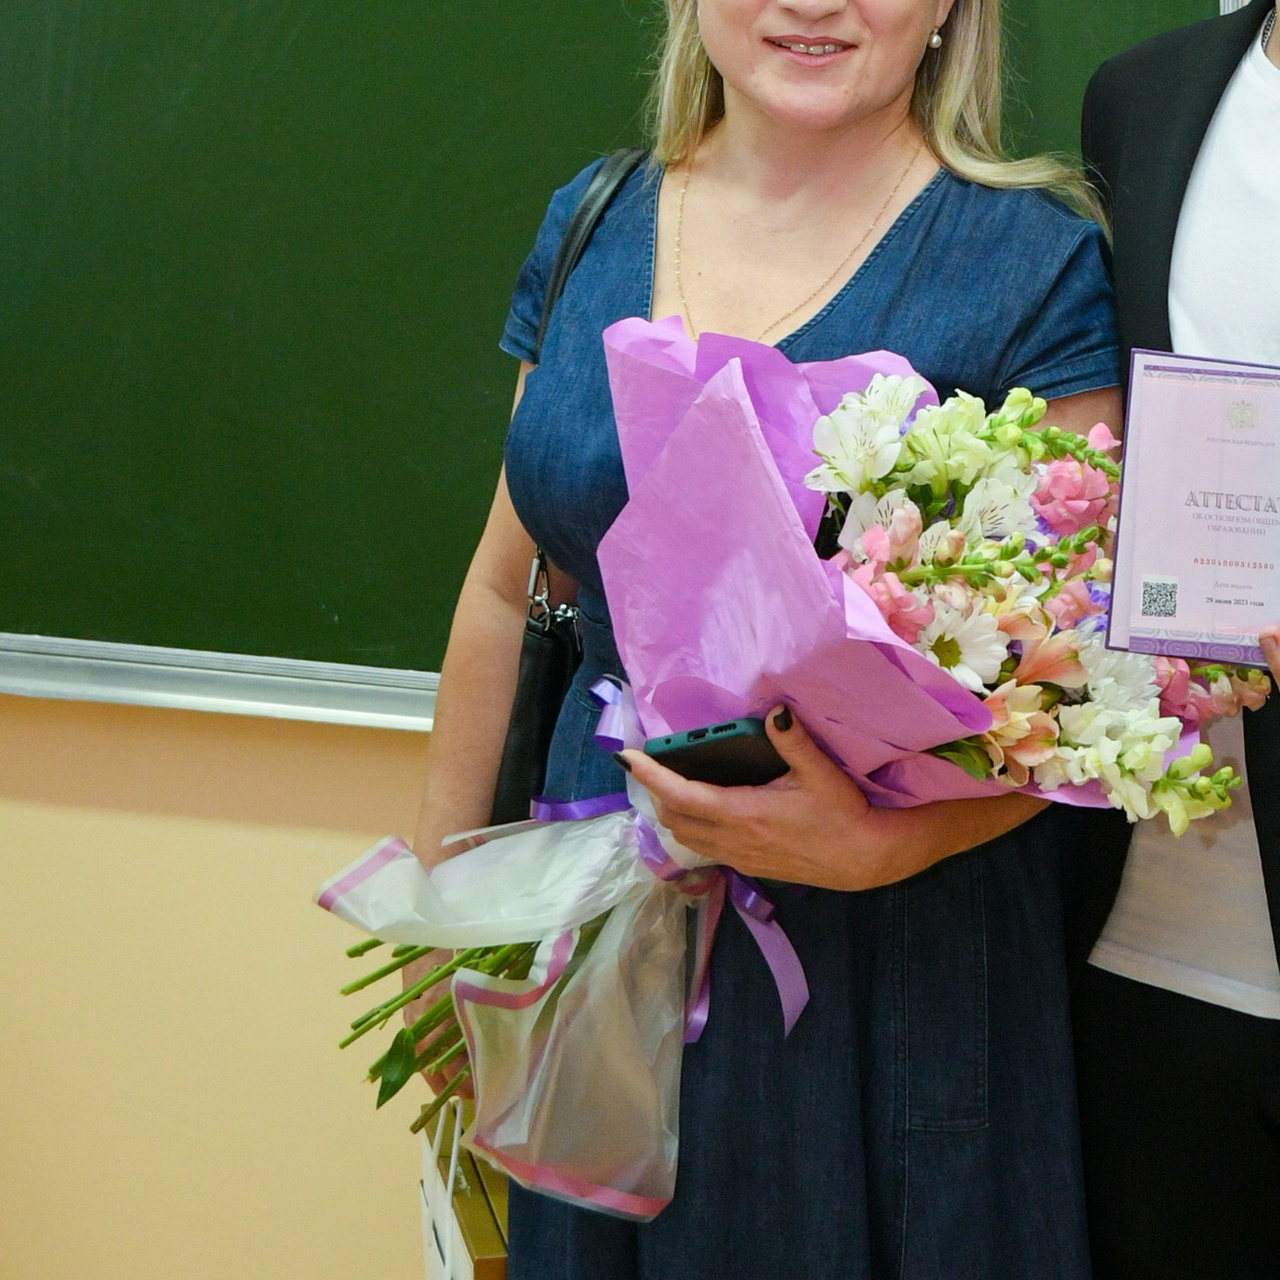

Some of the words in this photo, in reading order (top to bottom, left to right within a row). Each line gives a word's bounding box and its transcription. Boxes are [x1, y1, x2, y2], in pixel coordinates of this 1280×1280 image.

[1192, 512, 1203, 520] ОБ
[1204, 514, 1251, 523] ОСНОВНОМ
[1233, 598, 1248, 606] 2023
